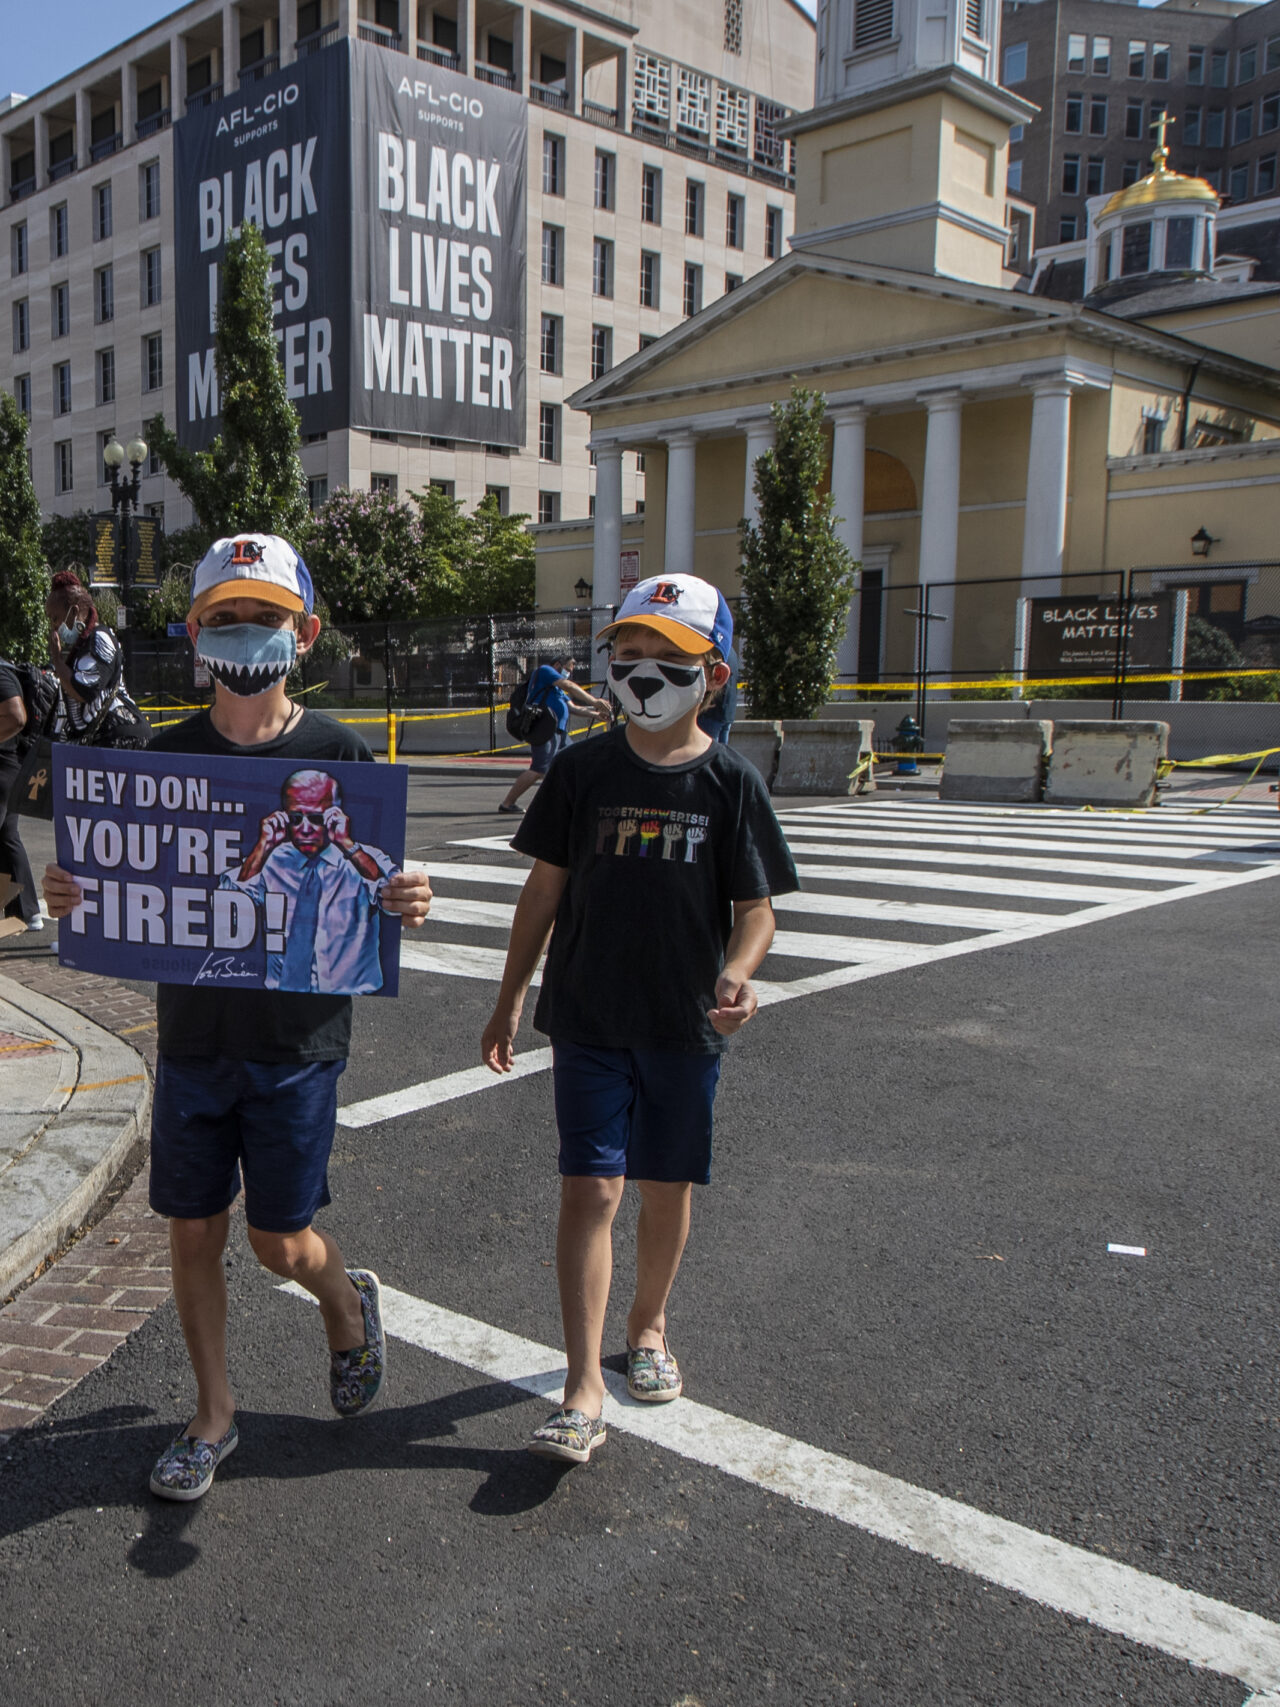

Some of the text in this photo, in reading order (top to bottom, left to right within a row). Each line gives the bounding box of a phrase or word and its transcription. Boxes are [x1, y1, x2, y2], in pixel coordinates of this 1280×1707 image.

[216, 83, 299, 137] AFL-CIO
[397, 76, 484, 119] AFL-CIO
[417, 109, 464, 132] SUPPORTS
[233, 120, 278, 147] SUPPORTS
[199, 136, 318, 253] BLACK
[378, 131, 501, 237] BLACK
[389, 227, 493, 321] LIVES
[363, 313, 513, 411] MATTER
[1043, 607, 1098, 623] BLACK
[66, 767, 245, 813] HEY DON...
[66, 816, 241, 876] YOU'RE
[71, 876, 287, 953] FIRED!
